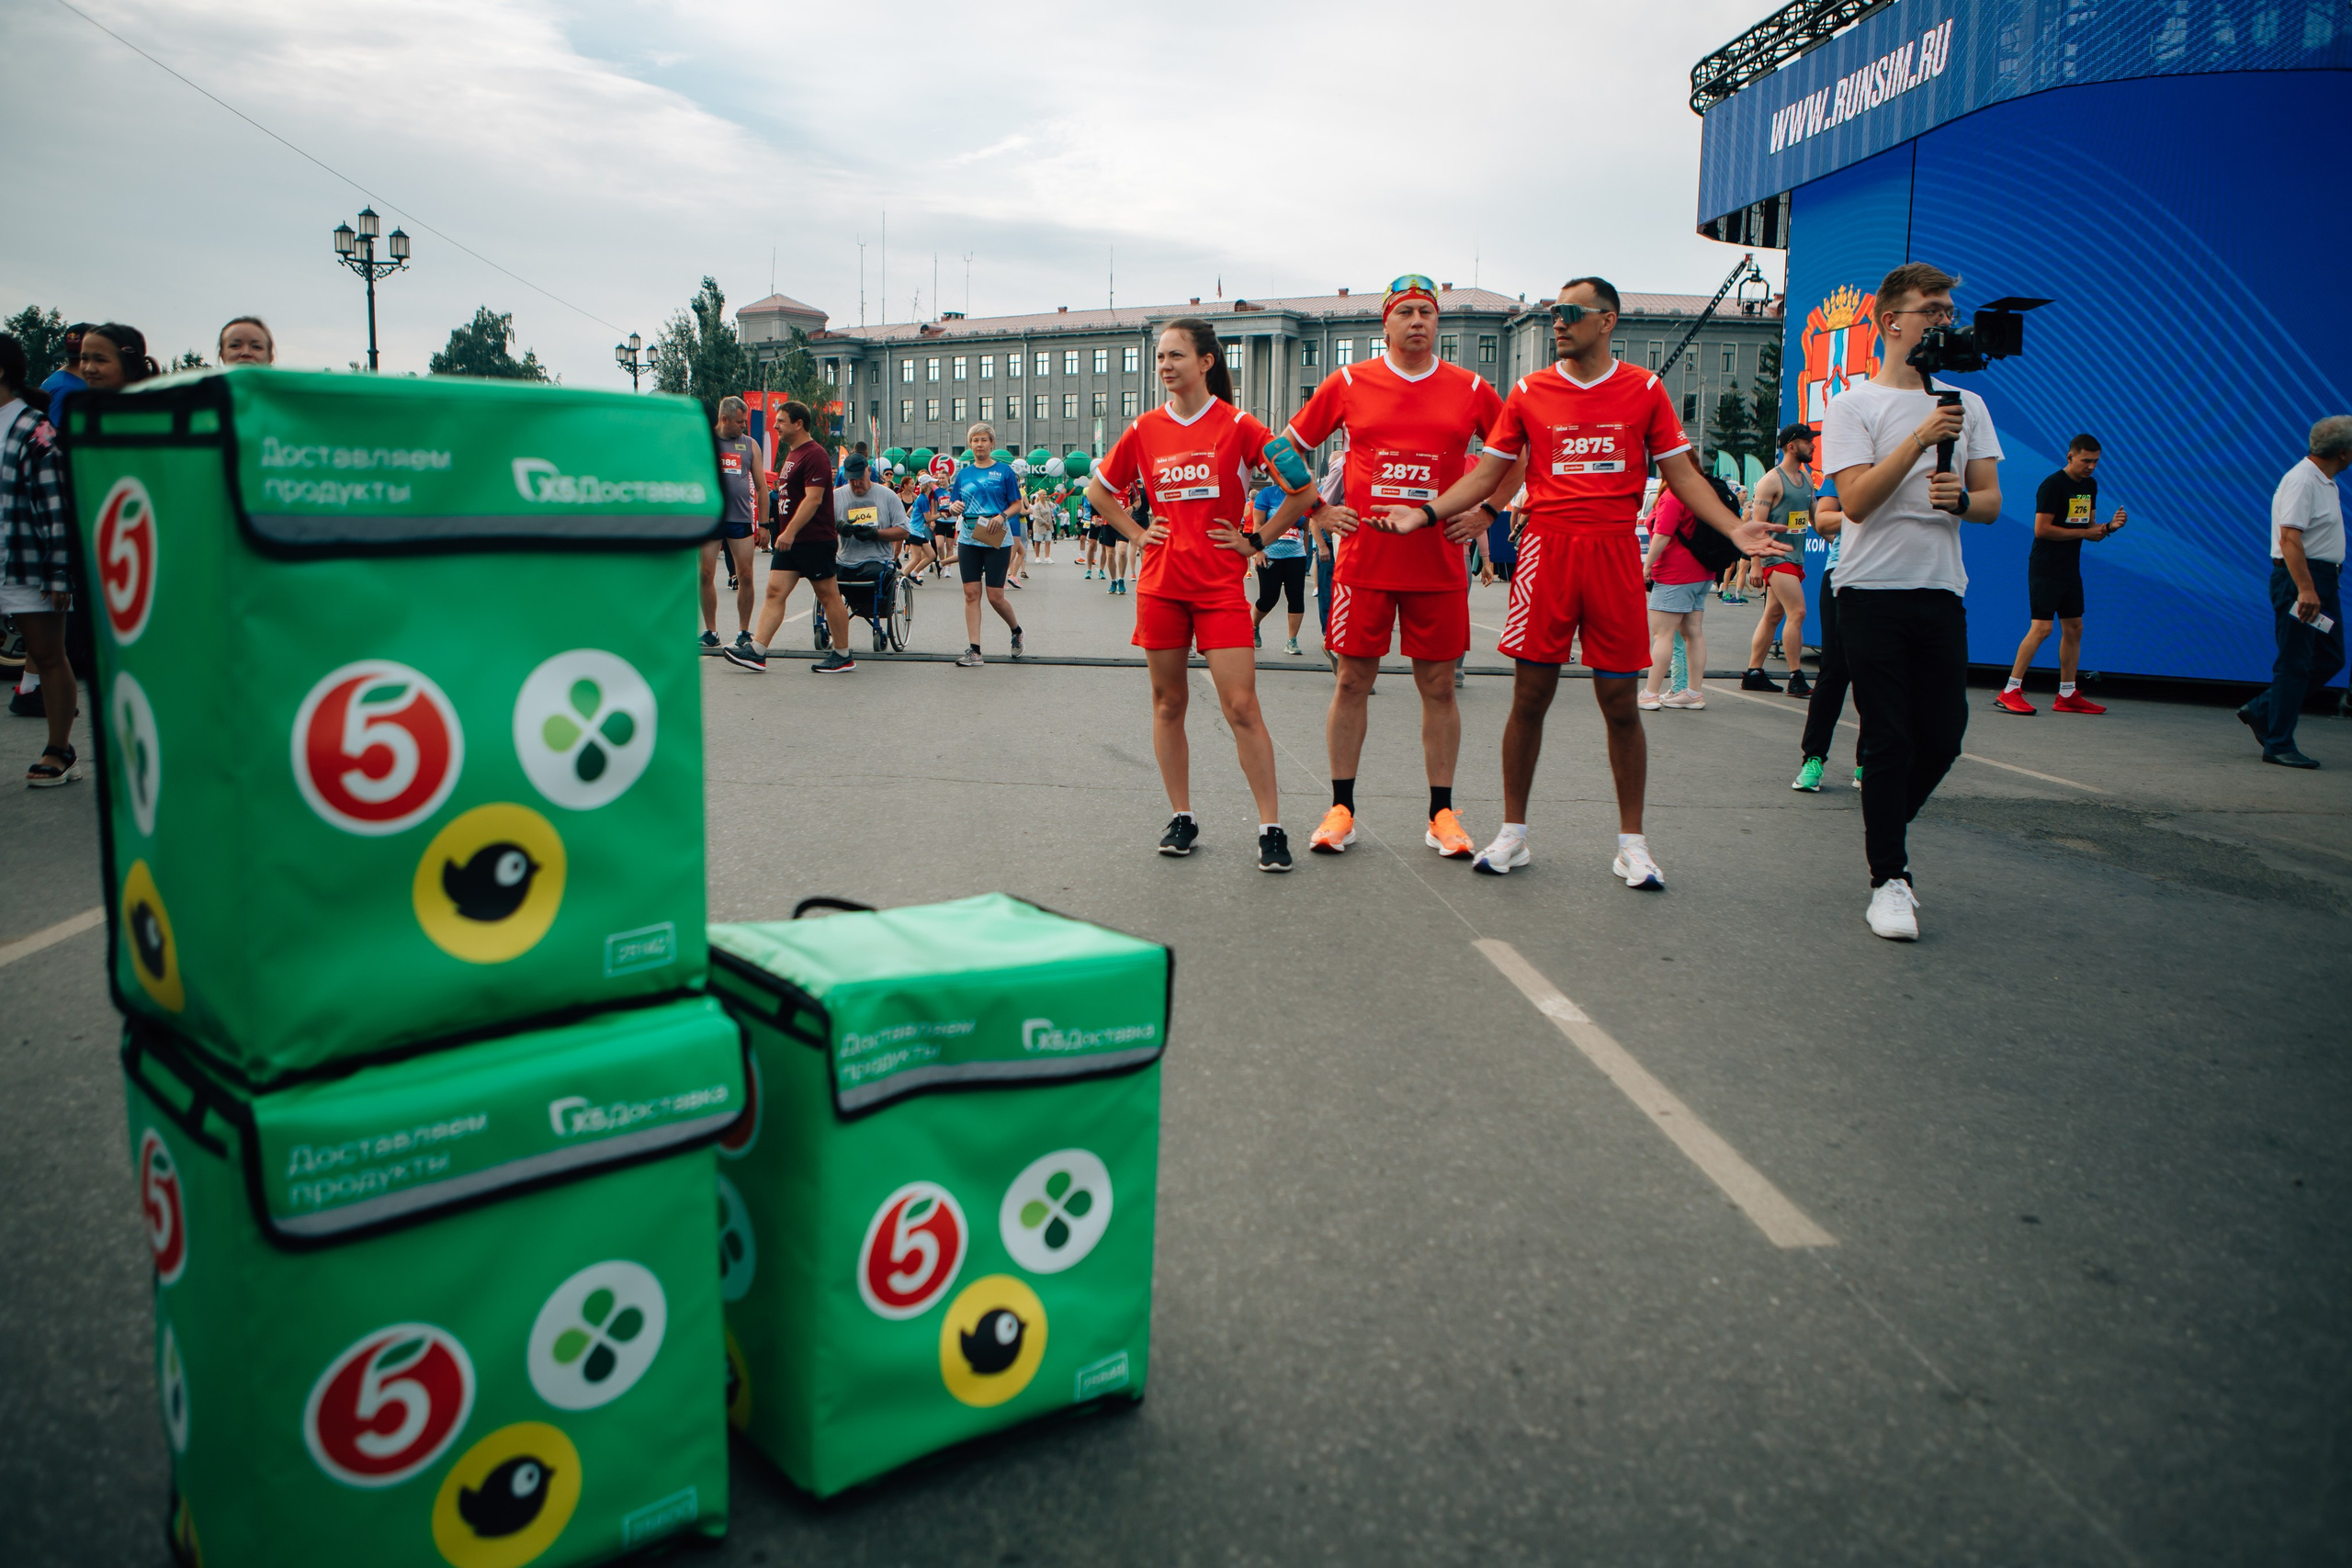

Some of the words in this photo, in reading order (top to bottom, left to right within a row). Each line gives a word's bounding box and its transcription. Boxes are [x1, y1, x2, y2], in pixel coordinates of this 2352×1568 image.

[1770, 17, 1952, 155] WWW.RUNSIM.RU
[261, 436, 452, 471] Доставляем
[1562, 436, 1615, 455] 2875
[1159, 464, 1210, 483] 2080
[1381, 463, 1430, 482] 2873
[264, 479, 413, 507] продукты
[854, 513, 872, 521] 404
[1794, 517, 1806, 525] 182
[2075, 505, 2087, 514] 276
[341, 677, 421, 804] 5
[286, 1112, 488, 1178] Доставляем
[289, 1153, 450, 1207] продукты
[888, 1193, 942, 1295] 5
[355, 1333, 435, 1458] 5
